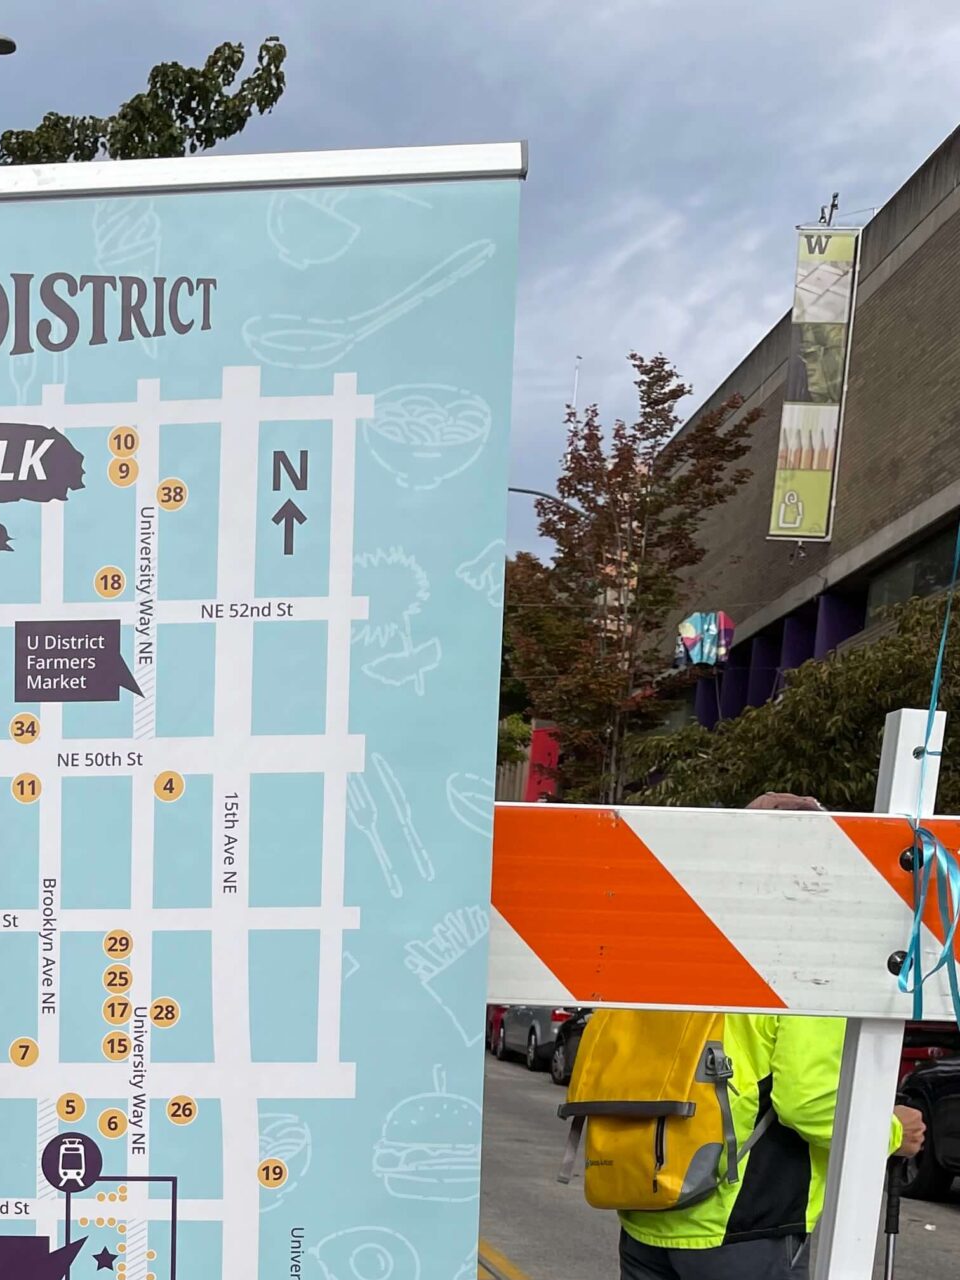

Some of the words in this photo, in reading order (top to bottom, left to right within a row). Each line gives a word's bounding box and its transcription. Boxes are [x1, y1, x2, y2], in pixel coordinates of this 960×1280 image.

[804, 234, 833, 255] W
[113, 433, 135, 450] 10
[118, 462, 130, 480] 9
[272, 450, 309, 491] N
[161, 486, 184, 503] 38
[136, 507, 155, 595] University
[100, 574, 122, 591] 18
[136, 599, 153, 636] Way
[201, 604, 224, 619] NE
[229, 602, 271, 618] 52nd
[277, 602, 294, 617] St
[27, 635, 39, 650] U
[44, 634, 105, 650] District
[139, 642, 153, 665] NE
[27, 655, 96, 670] Farmers
[27, 673, 87, 690] Market
[14, 720, 37, 737] 34
[57, 753, 79, 767] NE
[85, 751, 122, 767] 50th
[127, 752, 143, 766] St
[16, 780, 36, 796] 11
[163, 778, 175, 794] 4
[224, 792, 239, 829] 15th
[223, 834, 238, 866] Ave
[223, 871, 237, 894] NE
[2, 913, 19, 928] St
[38, 878, 57, 952] Brooklyn
[107, 936, 130, 952] 29
[42, 956, 56, 987] Ave
[41, 992, 56, 1014] NE
[18, 1044, 30, 1061] 7
[128, 1006, 148, 1089] University
[128, 1093, 146, 1129] Way
[171, 1102, 193, 1118] 26
[131, 1133, 146, 1155] NE
[262, 1165, 284, 1181] 19
[14, 1201, 30, 1215] St
